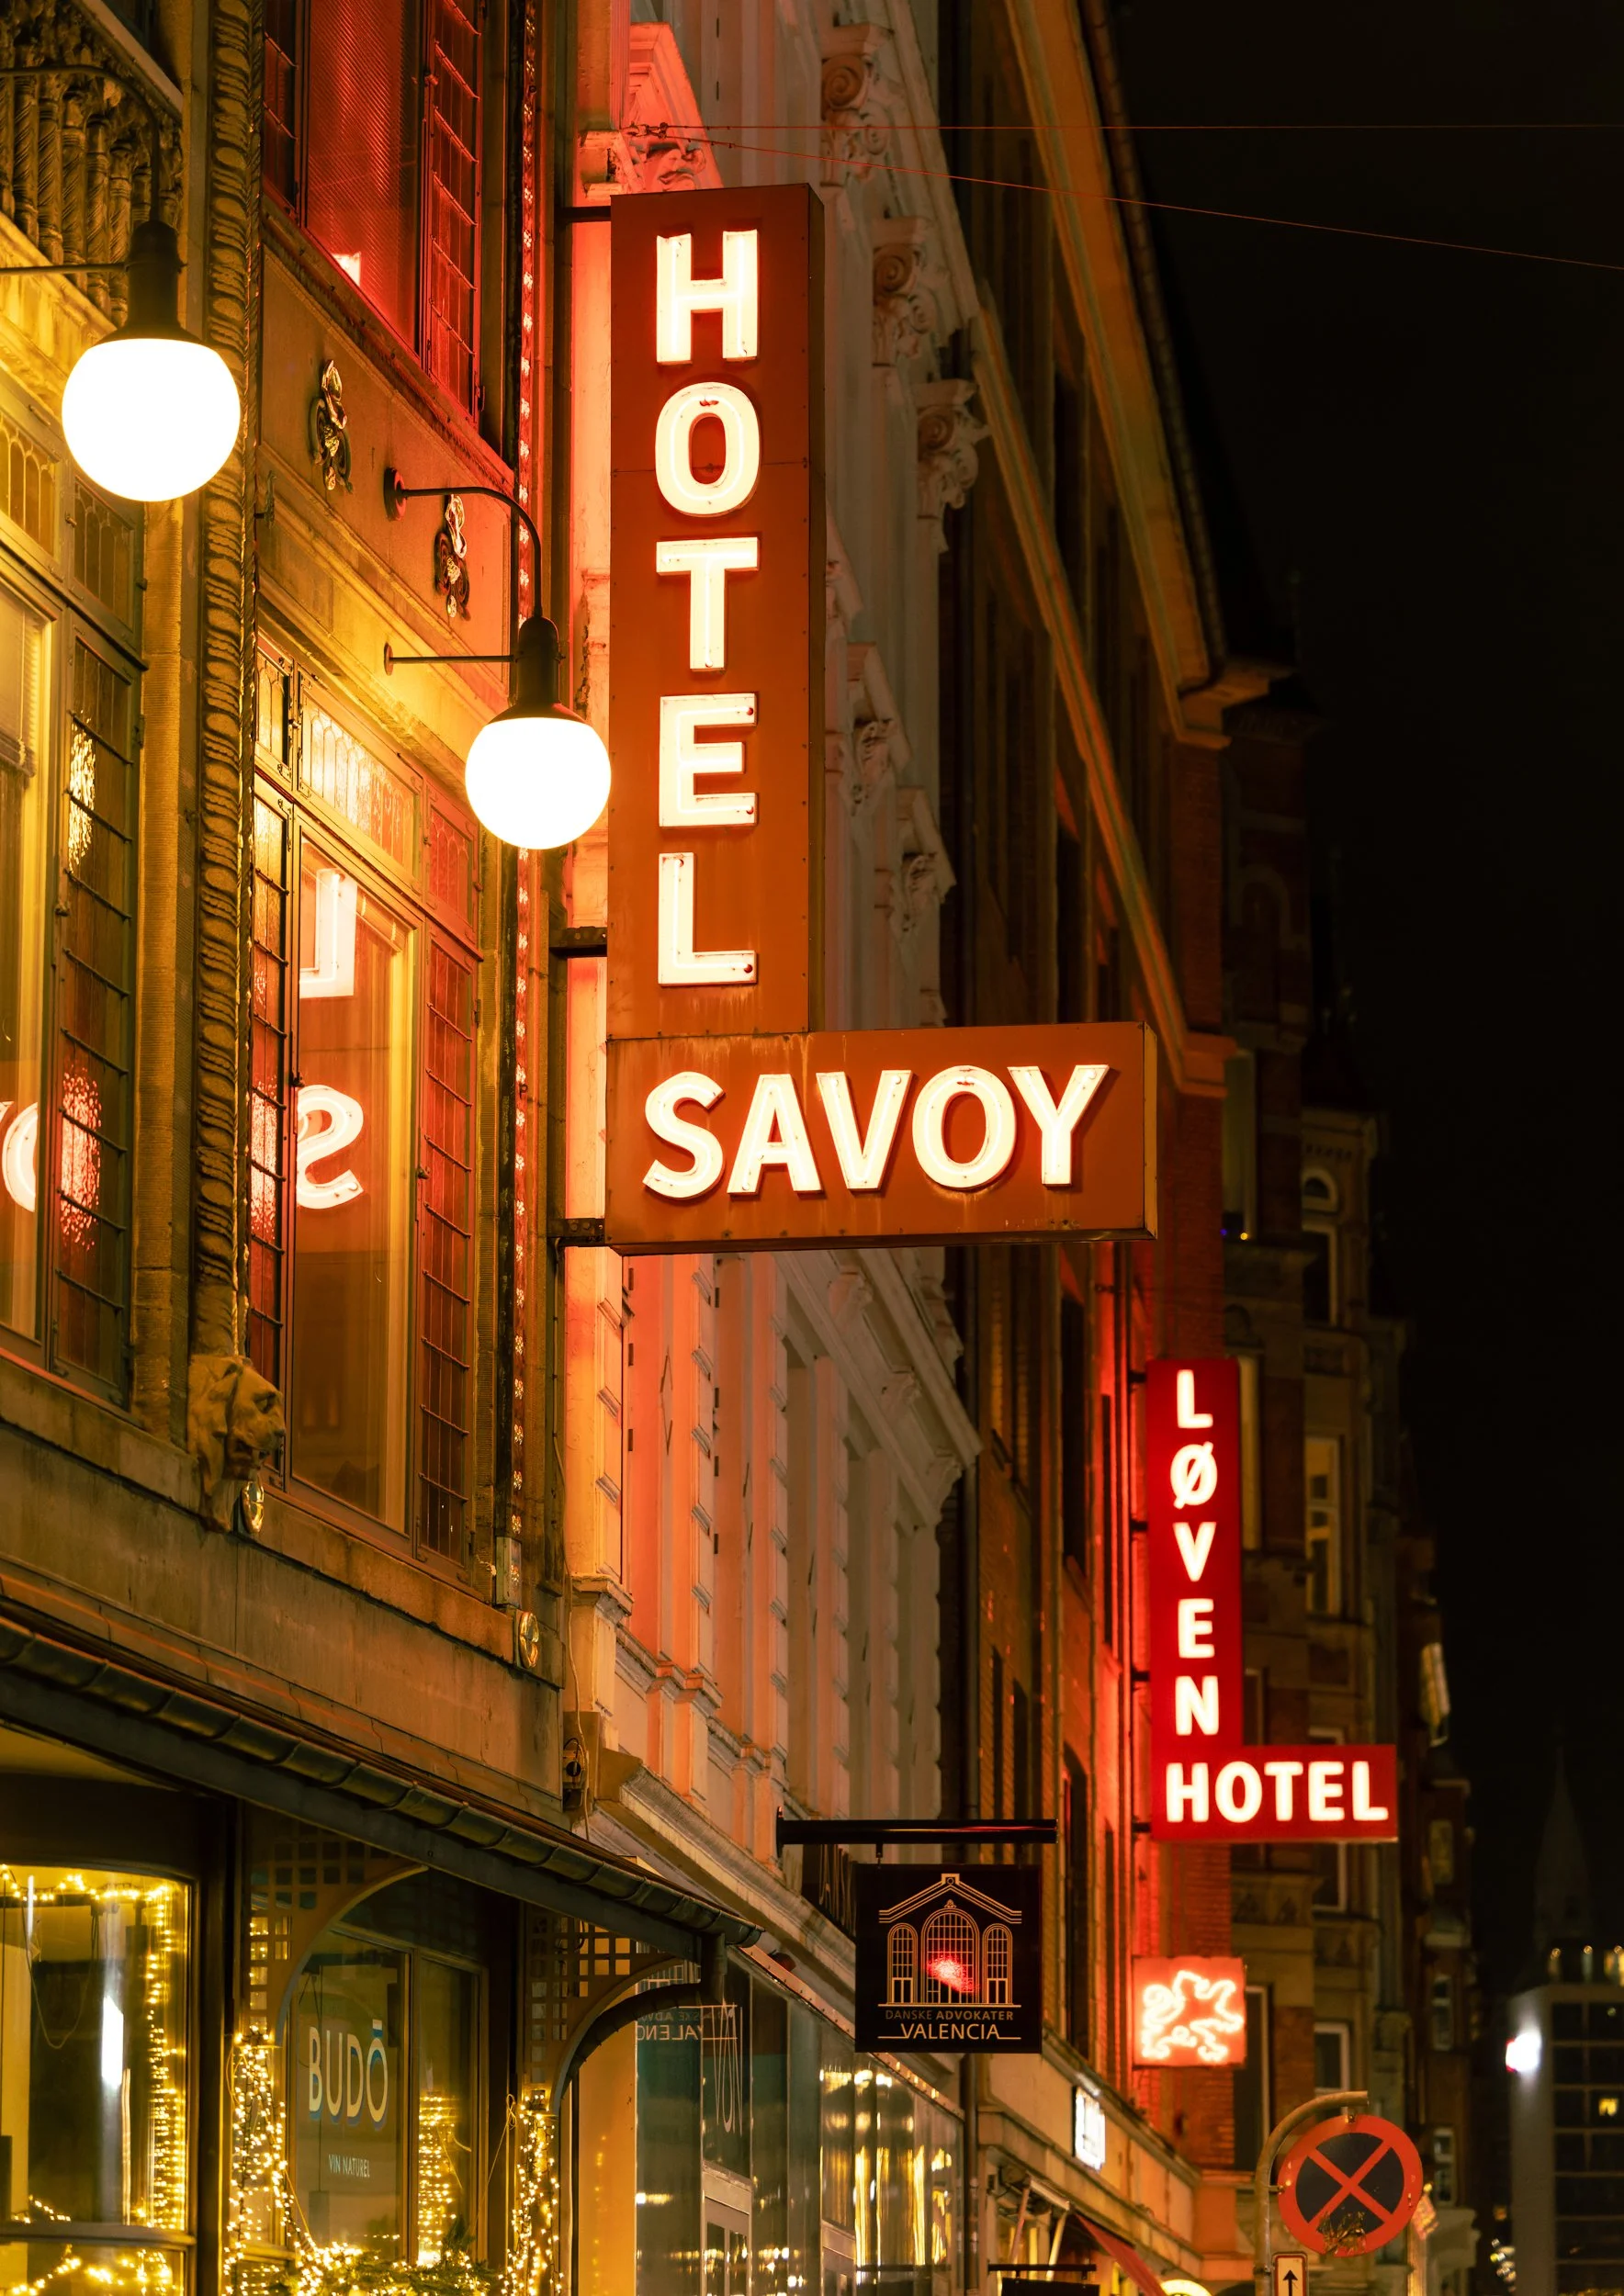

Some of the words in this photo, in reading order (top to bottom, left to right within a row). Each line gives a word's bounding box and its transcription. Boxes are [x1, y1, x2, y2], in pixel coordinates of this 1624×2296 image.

[656, 229, 760, 987] HOTEL
[642, 1064, 1110, 1199] SAVOY
[1169, 1368, 1220, 1737] LØVEN
[1165, 1760, 1390, 1824] HOTEL
[885, 2009, 932, 2020] DANSKE
[935, 2010, 1014, 2021] ADVOKATER
[900, 2023, 1001, 2040] VALENCIA
[328, 2154, 341, 2175] VIN
[343, 2155, 371, 2178] NATUREL
